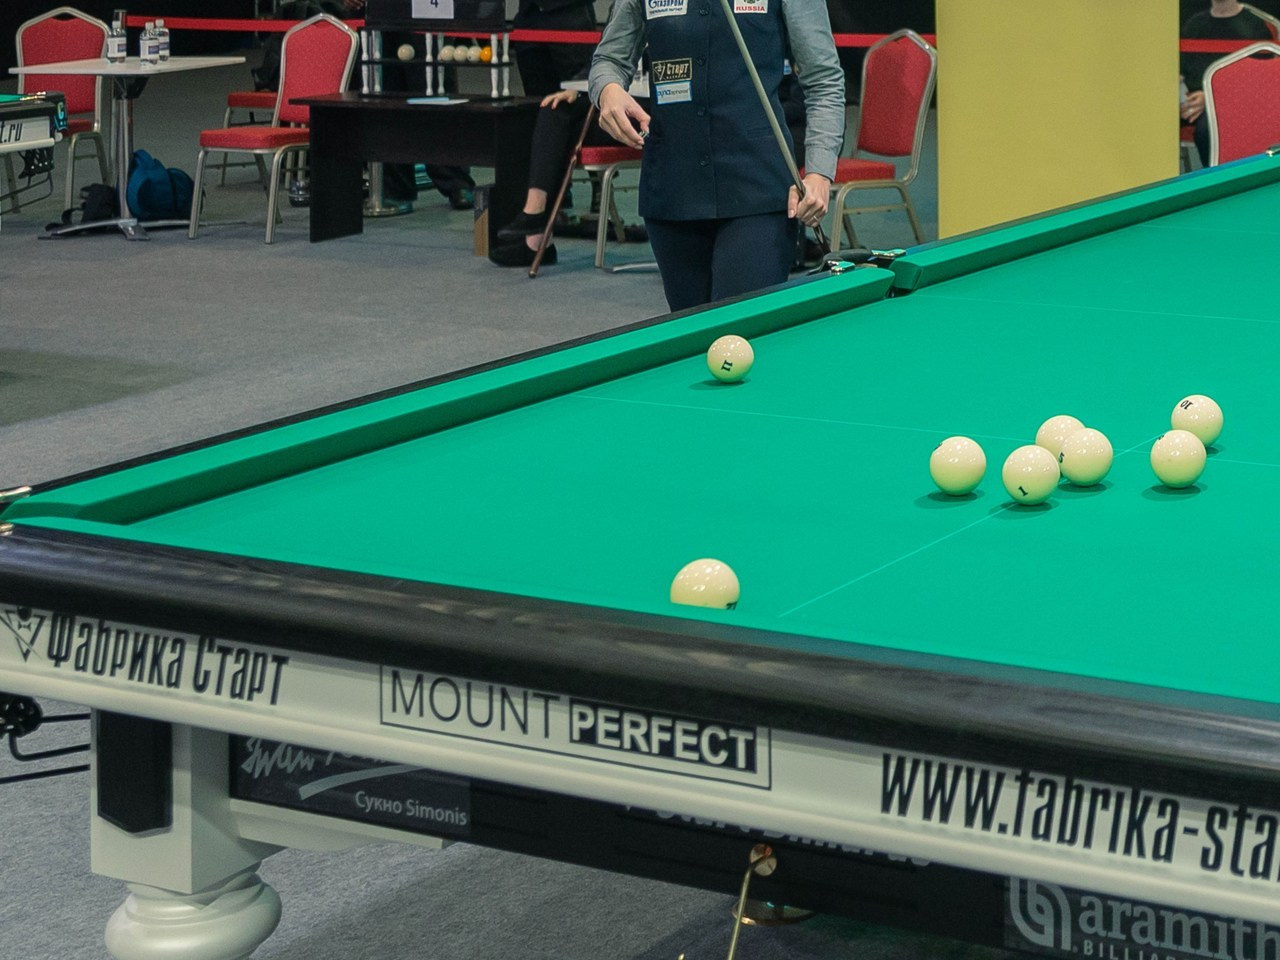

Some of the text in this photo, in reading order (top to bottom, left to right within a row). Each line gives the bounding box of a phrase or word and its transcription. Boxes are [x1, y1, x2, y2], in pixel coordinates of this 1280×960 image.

[666, 63, 689, 76] Старт
[47, 610, 290, 707] Фабрика Старт
[391, 669, 756, 770] MOUNT PERFECT
[355, 791, 468, 826] Сукно Simonis
[1083, 939, 1177, 960] BILLI
